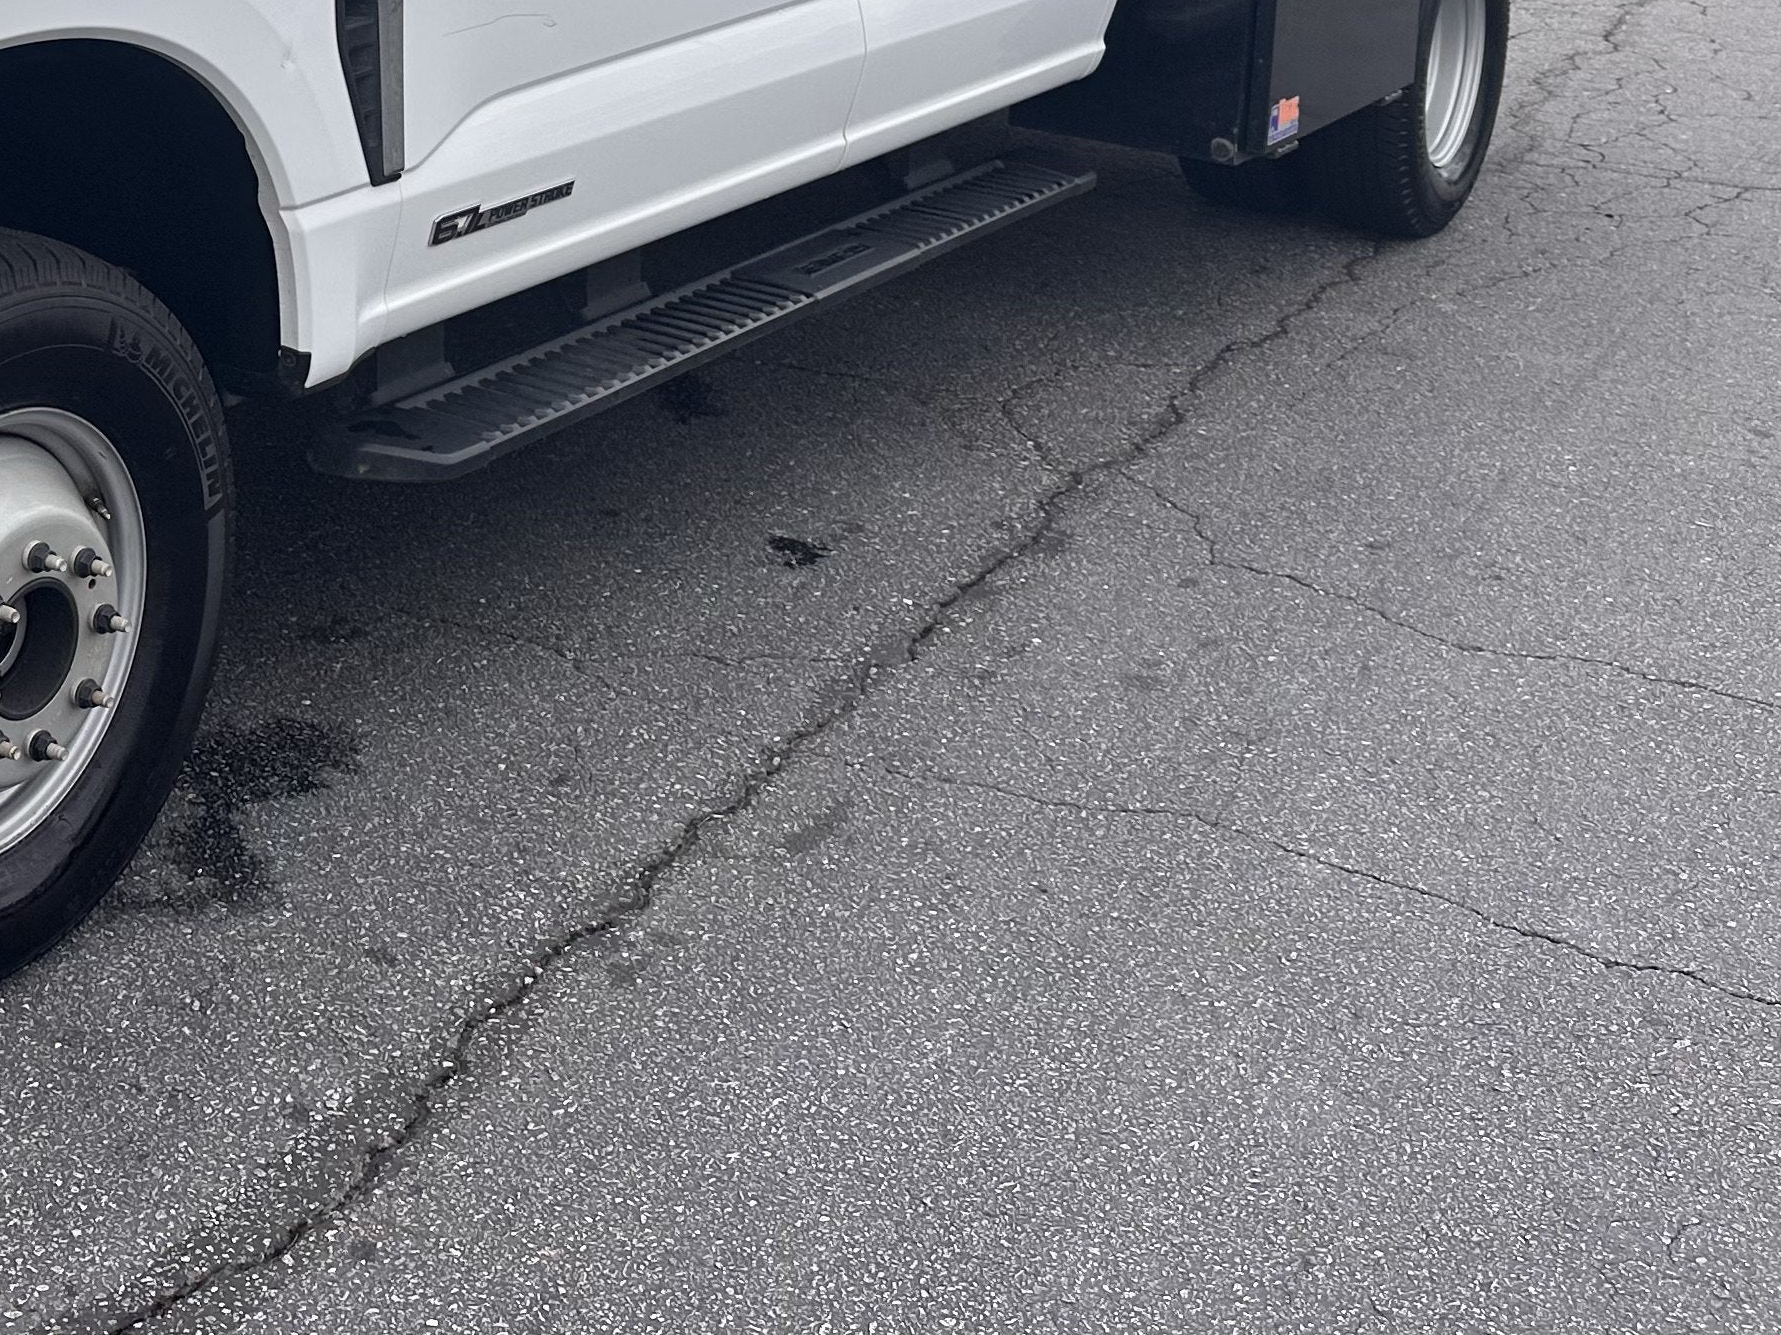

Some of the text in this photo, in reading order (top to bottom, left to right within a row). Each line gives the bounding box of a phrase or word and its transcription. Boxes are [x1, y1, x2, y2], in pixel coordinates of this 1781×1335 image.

[489, 198, 529, 222] POWER
[530, 184, 574, 209] STROKE
[143, 342, 224, 498] MICHELIN
